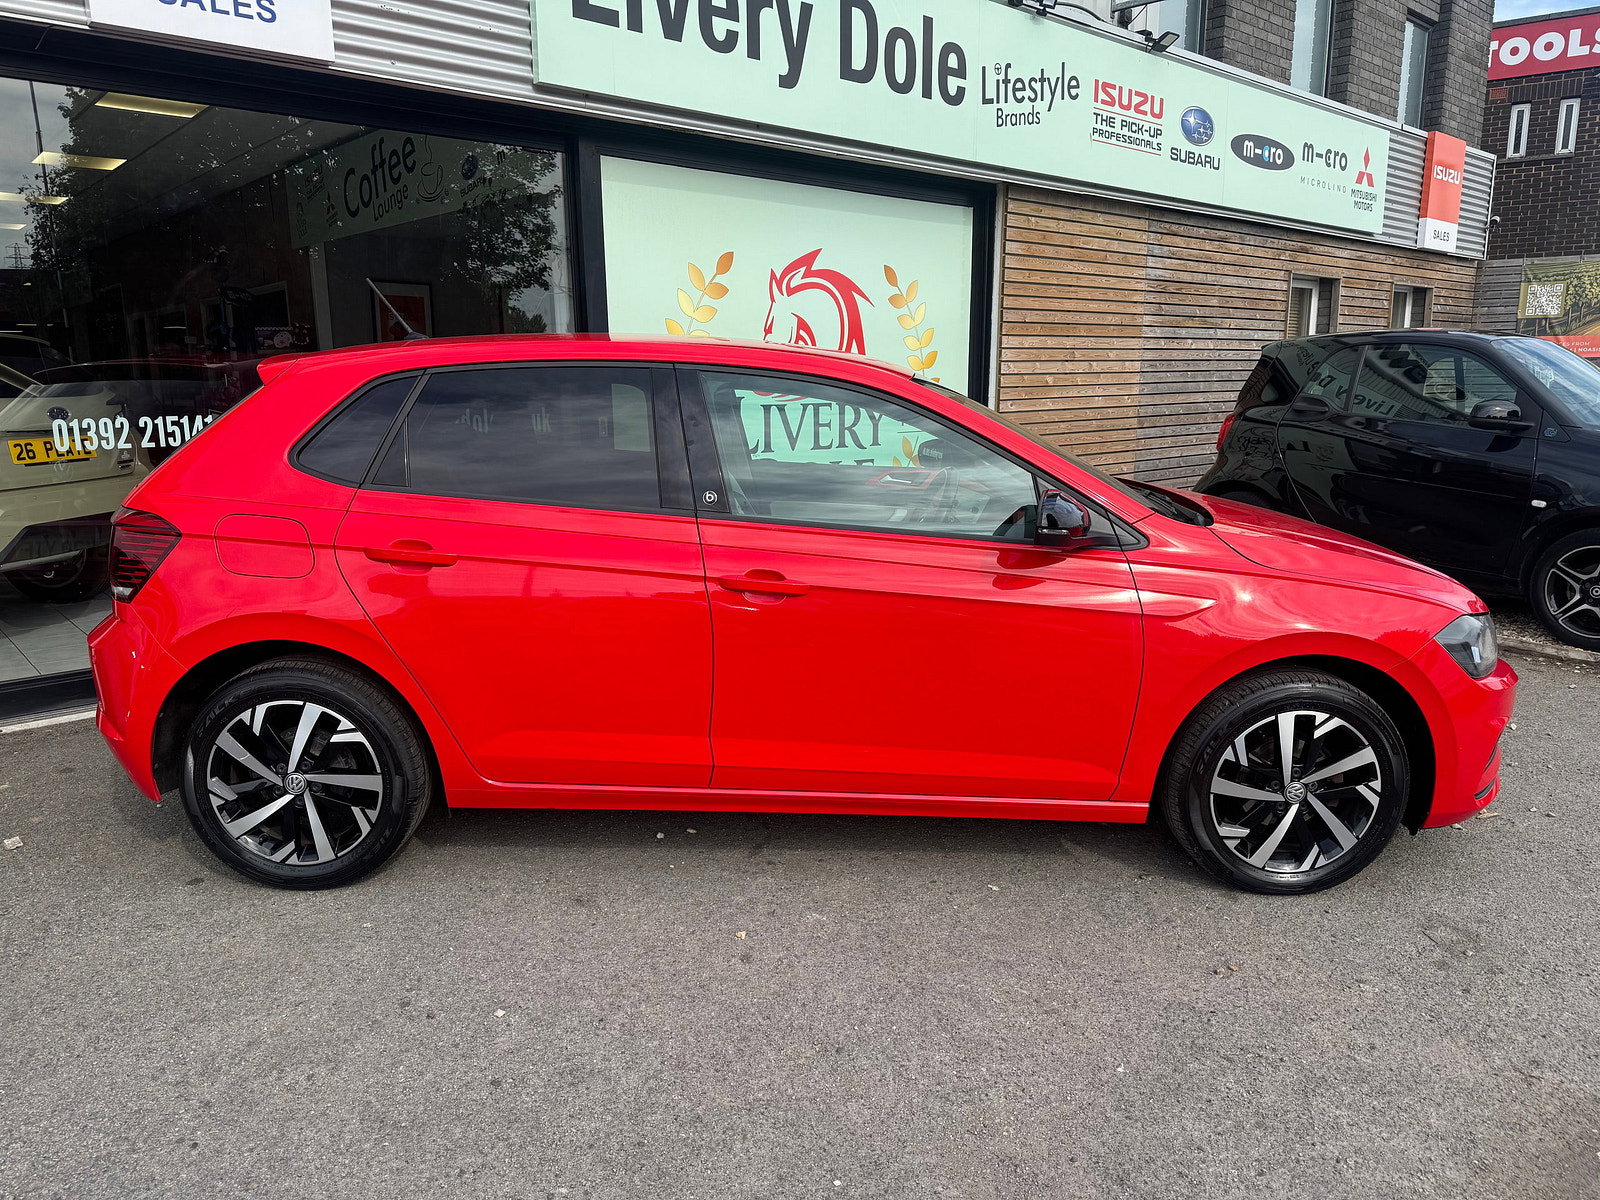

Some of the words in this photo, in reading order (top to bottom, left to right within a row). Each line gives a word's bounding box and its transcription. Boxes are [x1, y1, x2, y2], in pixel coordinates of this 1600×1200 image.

[839, 0, 967, 107] Dole
[981, 62, 1080, 112] Lifestyle
[1093, 79, 1164, 119] ISUZU
[996, 105, 1041, 128] Brands
[1093, 112, 1116, 129] THE
[1120, 118, 1163, 140] PICK-UP
[1092, 127, 1162, 152] PROFESSIONALS
[1170, 147, 1221, 171] SUBARU
[343, 136, 417, 218] Coffee
[1300, 175, 1347, 194] MICROLINO
[1433, 165, 1461, 185] ISUZU
[372, 183, 409, 222] Lounge
[1350, 188, 1378, 201] MITSUBISHI
[1353, 200, 1373, 212] MOTORS
[1432, 229, 1450, 242] SALES
[52, 416, 132, 452] 01392
[13, 442, 37, 461] 26
